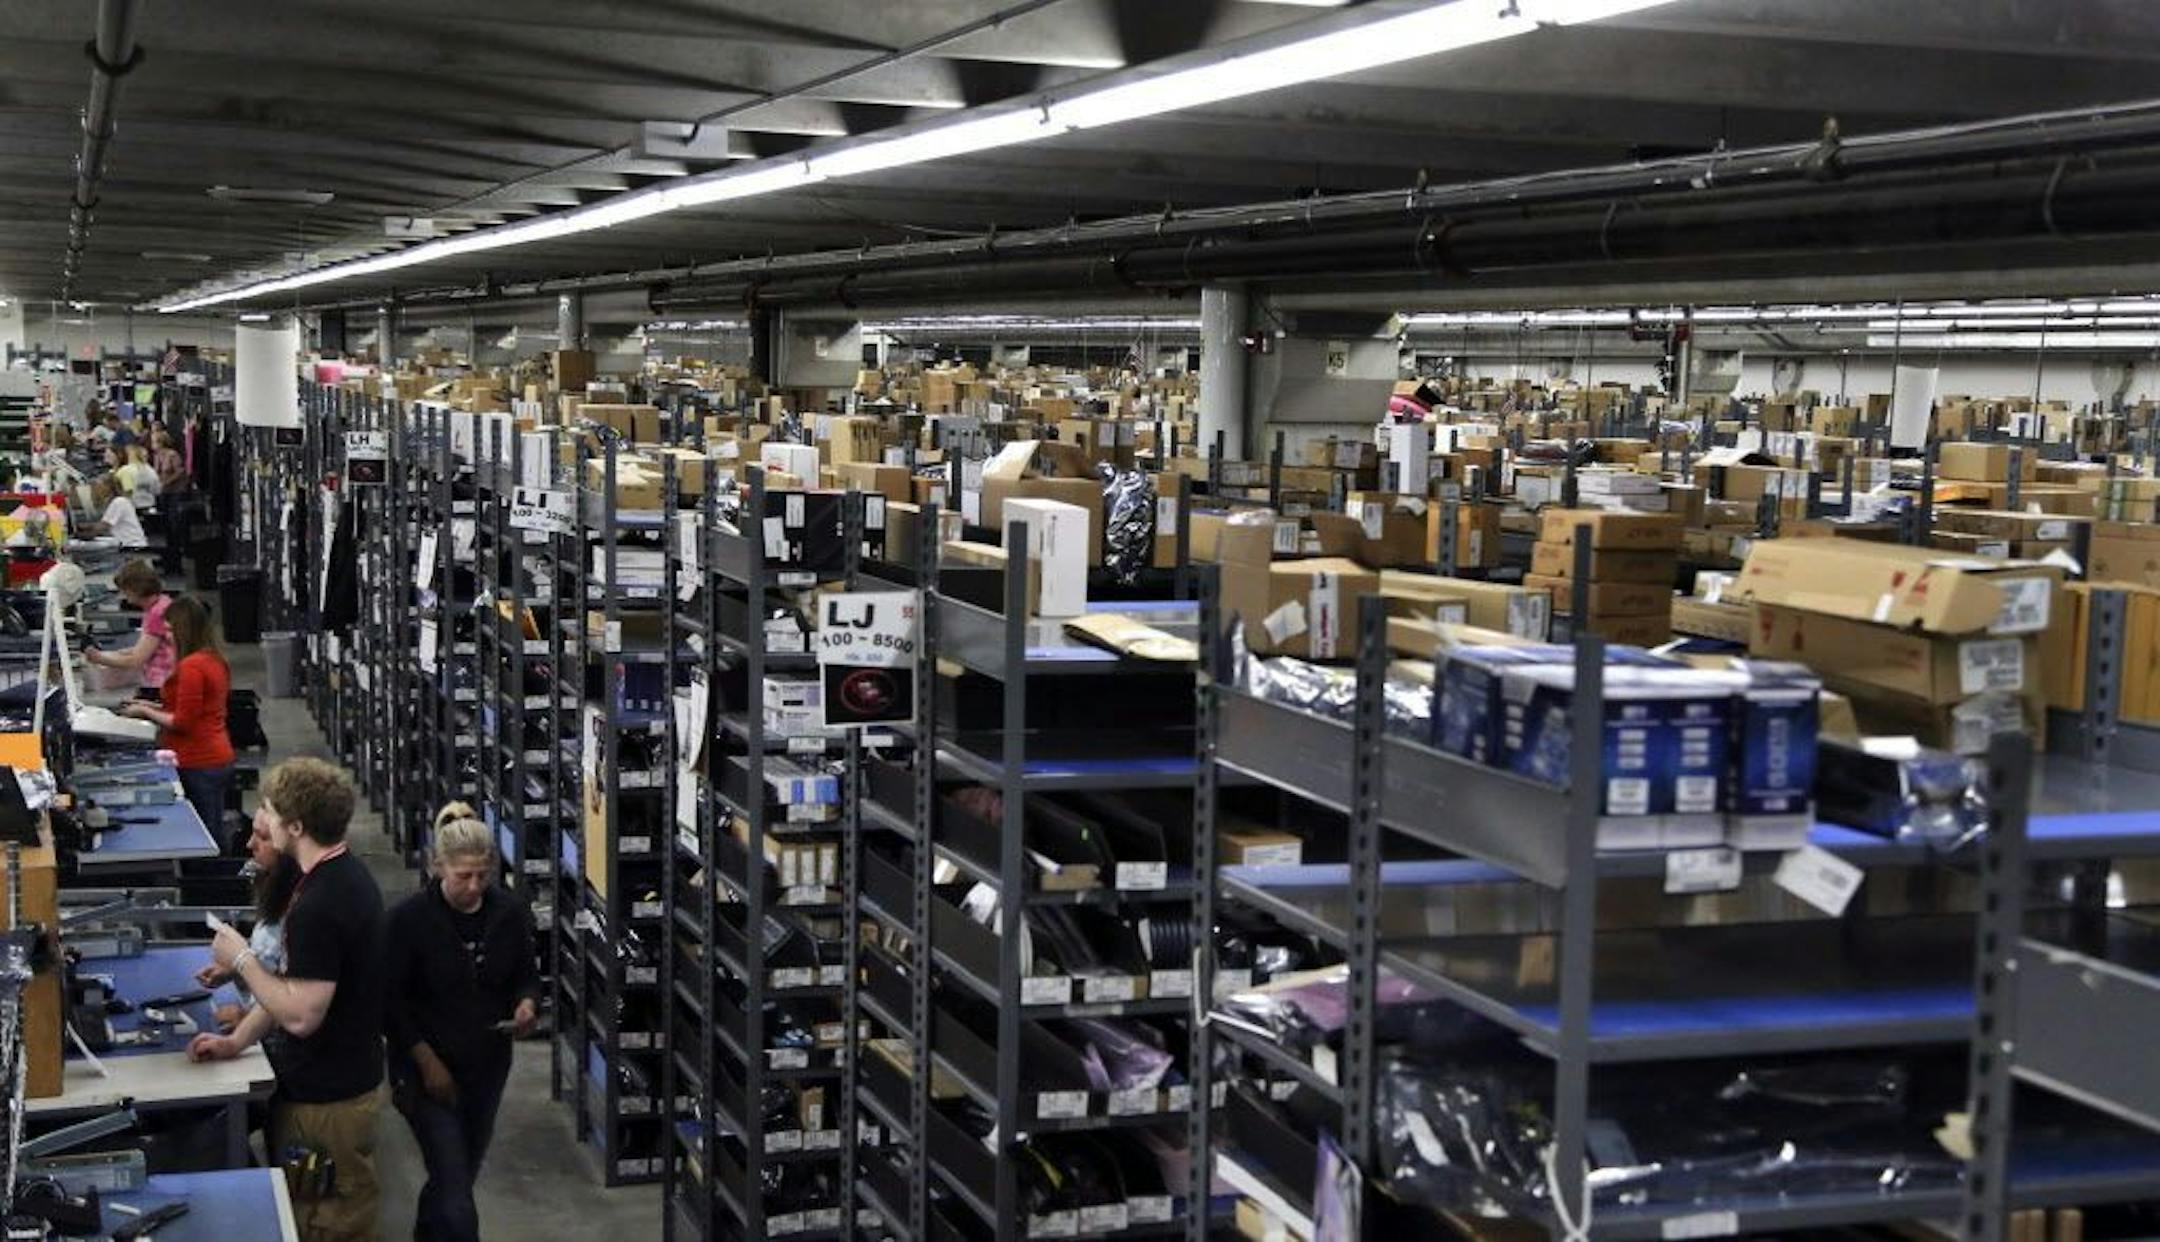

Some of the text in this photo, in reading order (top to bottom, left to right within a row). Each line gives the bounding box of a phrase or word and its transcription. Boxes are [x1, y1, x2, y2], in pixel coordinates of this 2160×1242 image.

[350, 434, 369, 444] LH
[517, 490, 547, 508] LI
[828, 601, 874, 628] LJ
[822, 632, 852, 648] 100
[872, 634, 914, 654] 8500
